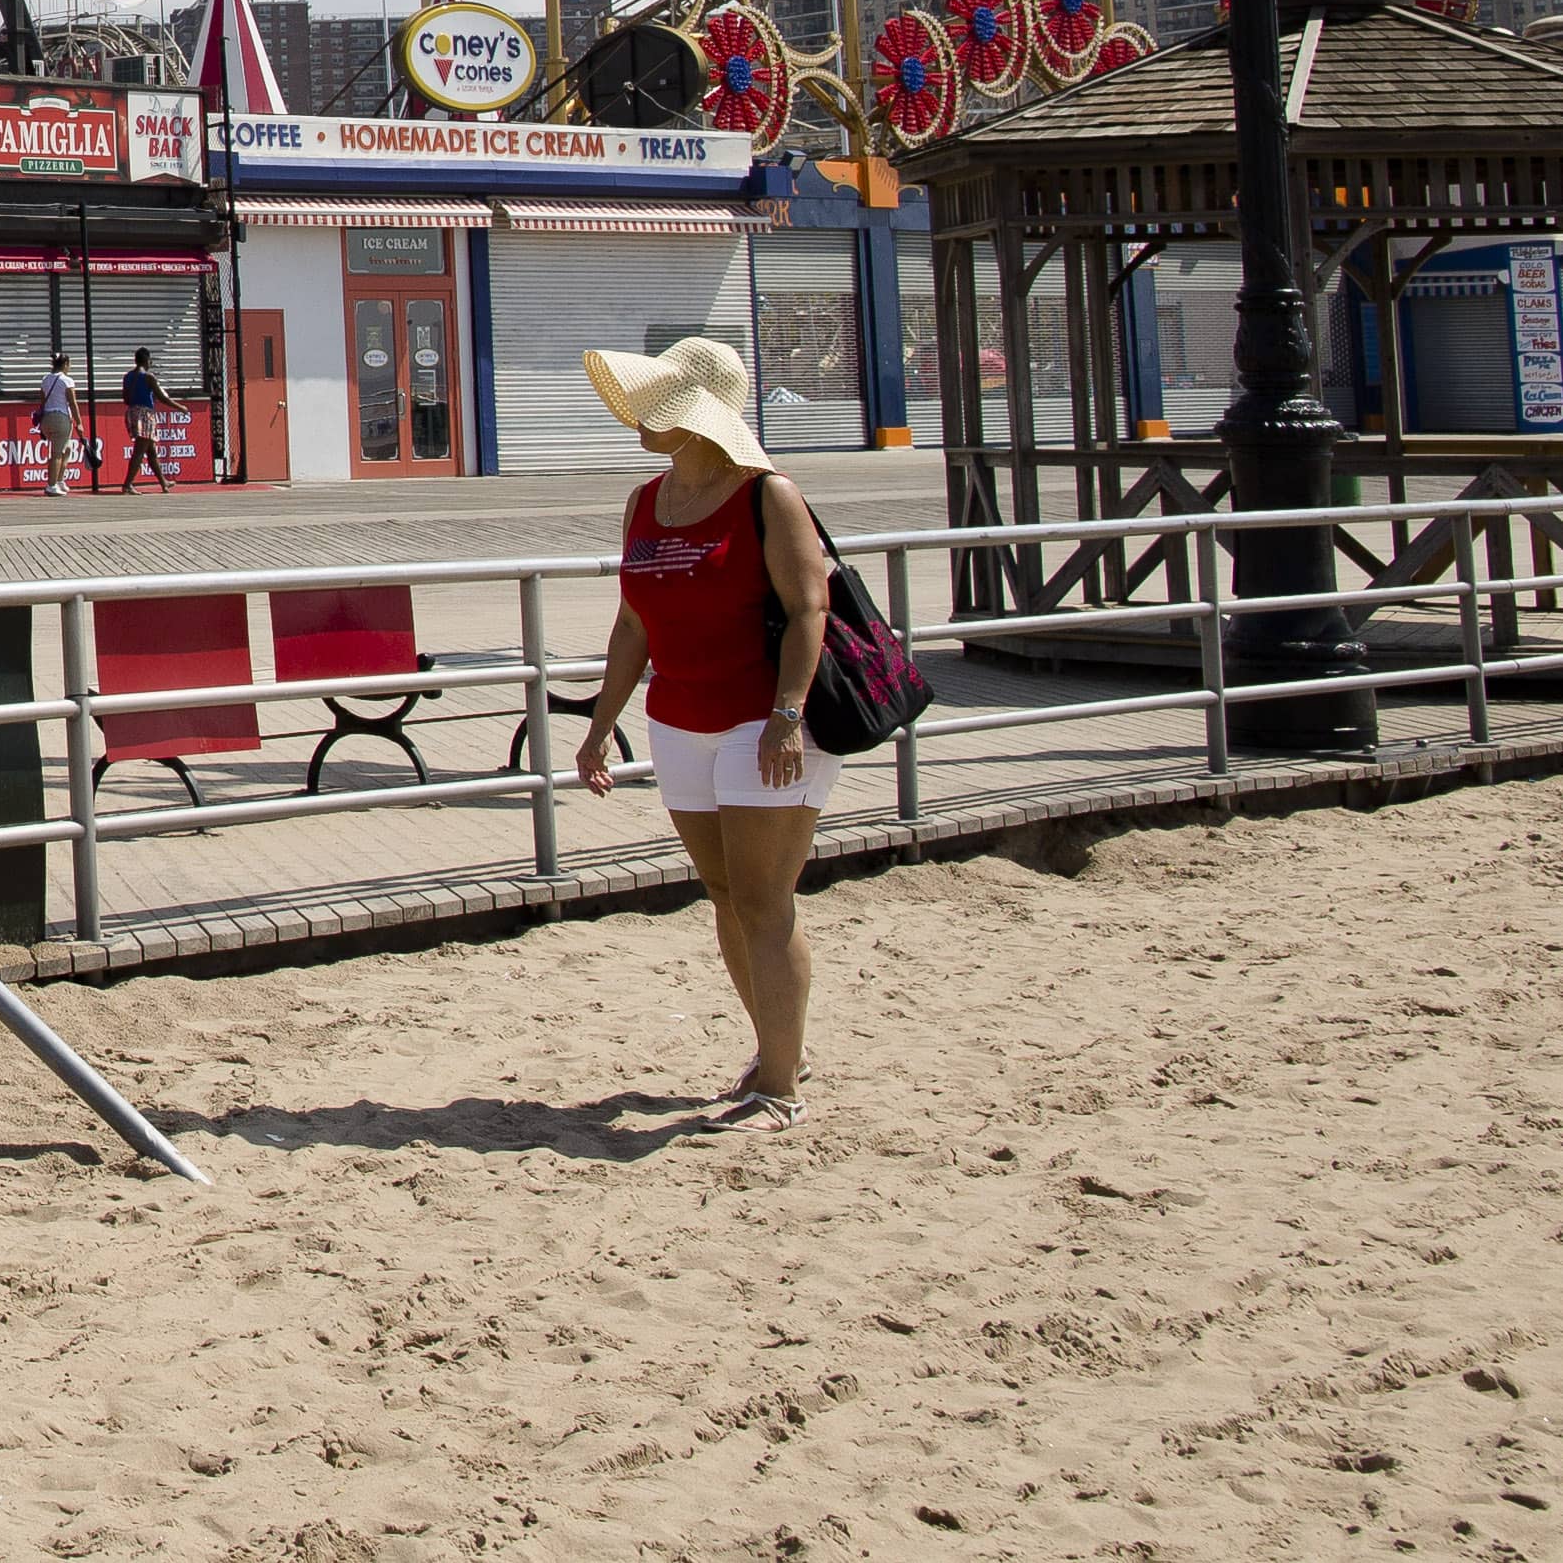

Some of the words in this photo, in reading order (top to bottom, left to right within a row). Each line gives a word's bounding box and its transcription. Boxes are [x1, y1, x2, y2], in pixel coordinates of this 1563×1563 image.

[418, 26, 522, 64] coney's
[454, 64, 514, 83] cones
[135, 114, 194, 137] SNACK
[218, 122, 302, 148] COFFEE
[340, 123, 477, 153] HOMEMADE
[483, 130, 520, 155] ICE
[526, 131, 605, 159] CREAM
[148, 137, 183, 158] BAR
[639, 137, 707, 161] TREATS
[27, 160, 77, 172] PIZZERIA
[150, 161, 167, 170] SINCE
[363, 238, 384, 250] ICE
[386, 238, 428, 250] CREAM
[1517, 269, 1546, 279] BEER
[1520, 280, 1547, 289] SODAS
[1517, 298, 1553, 309] CLAMS
[1532, 338, 1557, 350] Fries
[169, 411, 192, 424] ICES
[1524, 406, 1562, 419] CHICKEN
[154, 428, 187, 441] REAM
[169, 444, 196, 458] BEER
[23, 469, 49, 482] SINC
[64, 468, 81, 481] 970
